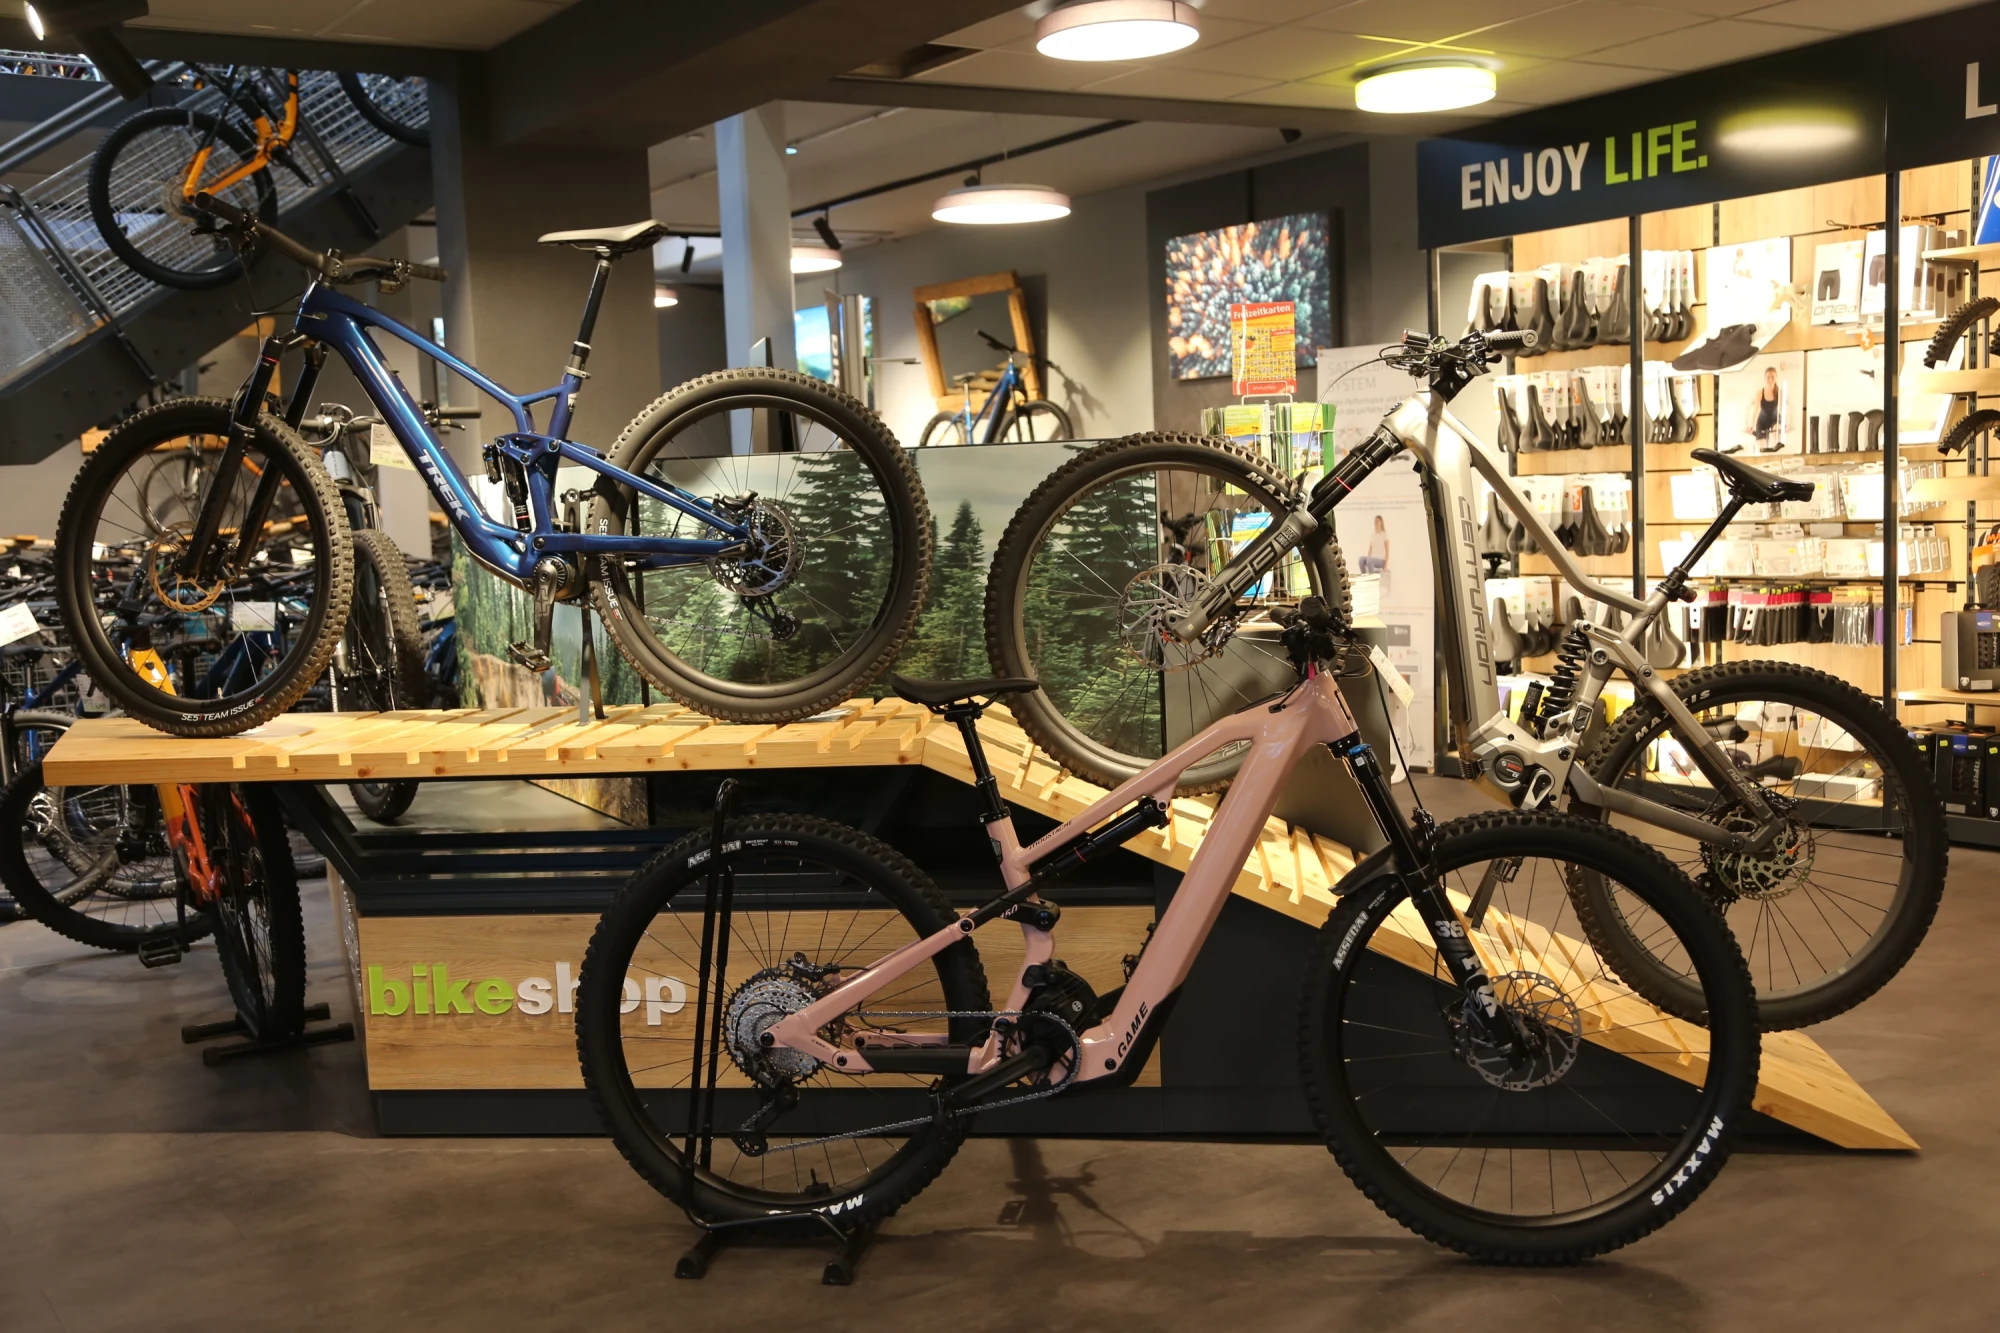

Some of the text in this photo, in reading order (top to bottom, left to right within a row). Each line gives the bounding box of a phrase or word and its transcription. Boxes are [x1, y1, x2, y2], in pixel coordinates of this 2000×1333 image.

[1461, 120, 1708, 210] ENJOY LIFE.
[1328, 376, 1376, 393] SYSTEM
[419, 448, 471, 520] TREK
[602, 578, 619, 609] ISSUE
[203, 710, 229, 721] TEAM
[230, 698, 255, 716] ISSUE
[1727, 768, 1763, 808] no pogo
[1434, 920, 1466, 939] 36
[1117, 1001, 1149, 1058] GAME
[1651, 1114, 1724, 1206] MAXXIS
